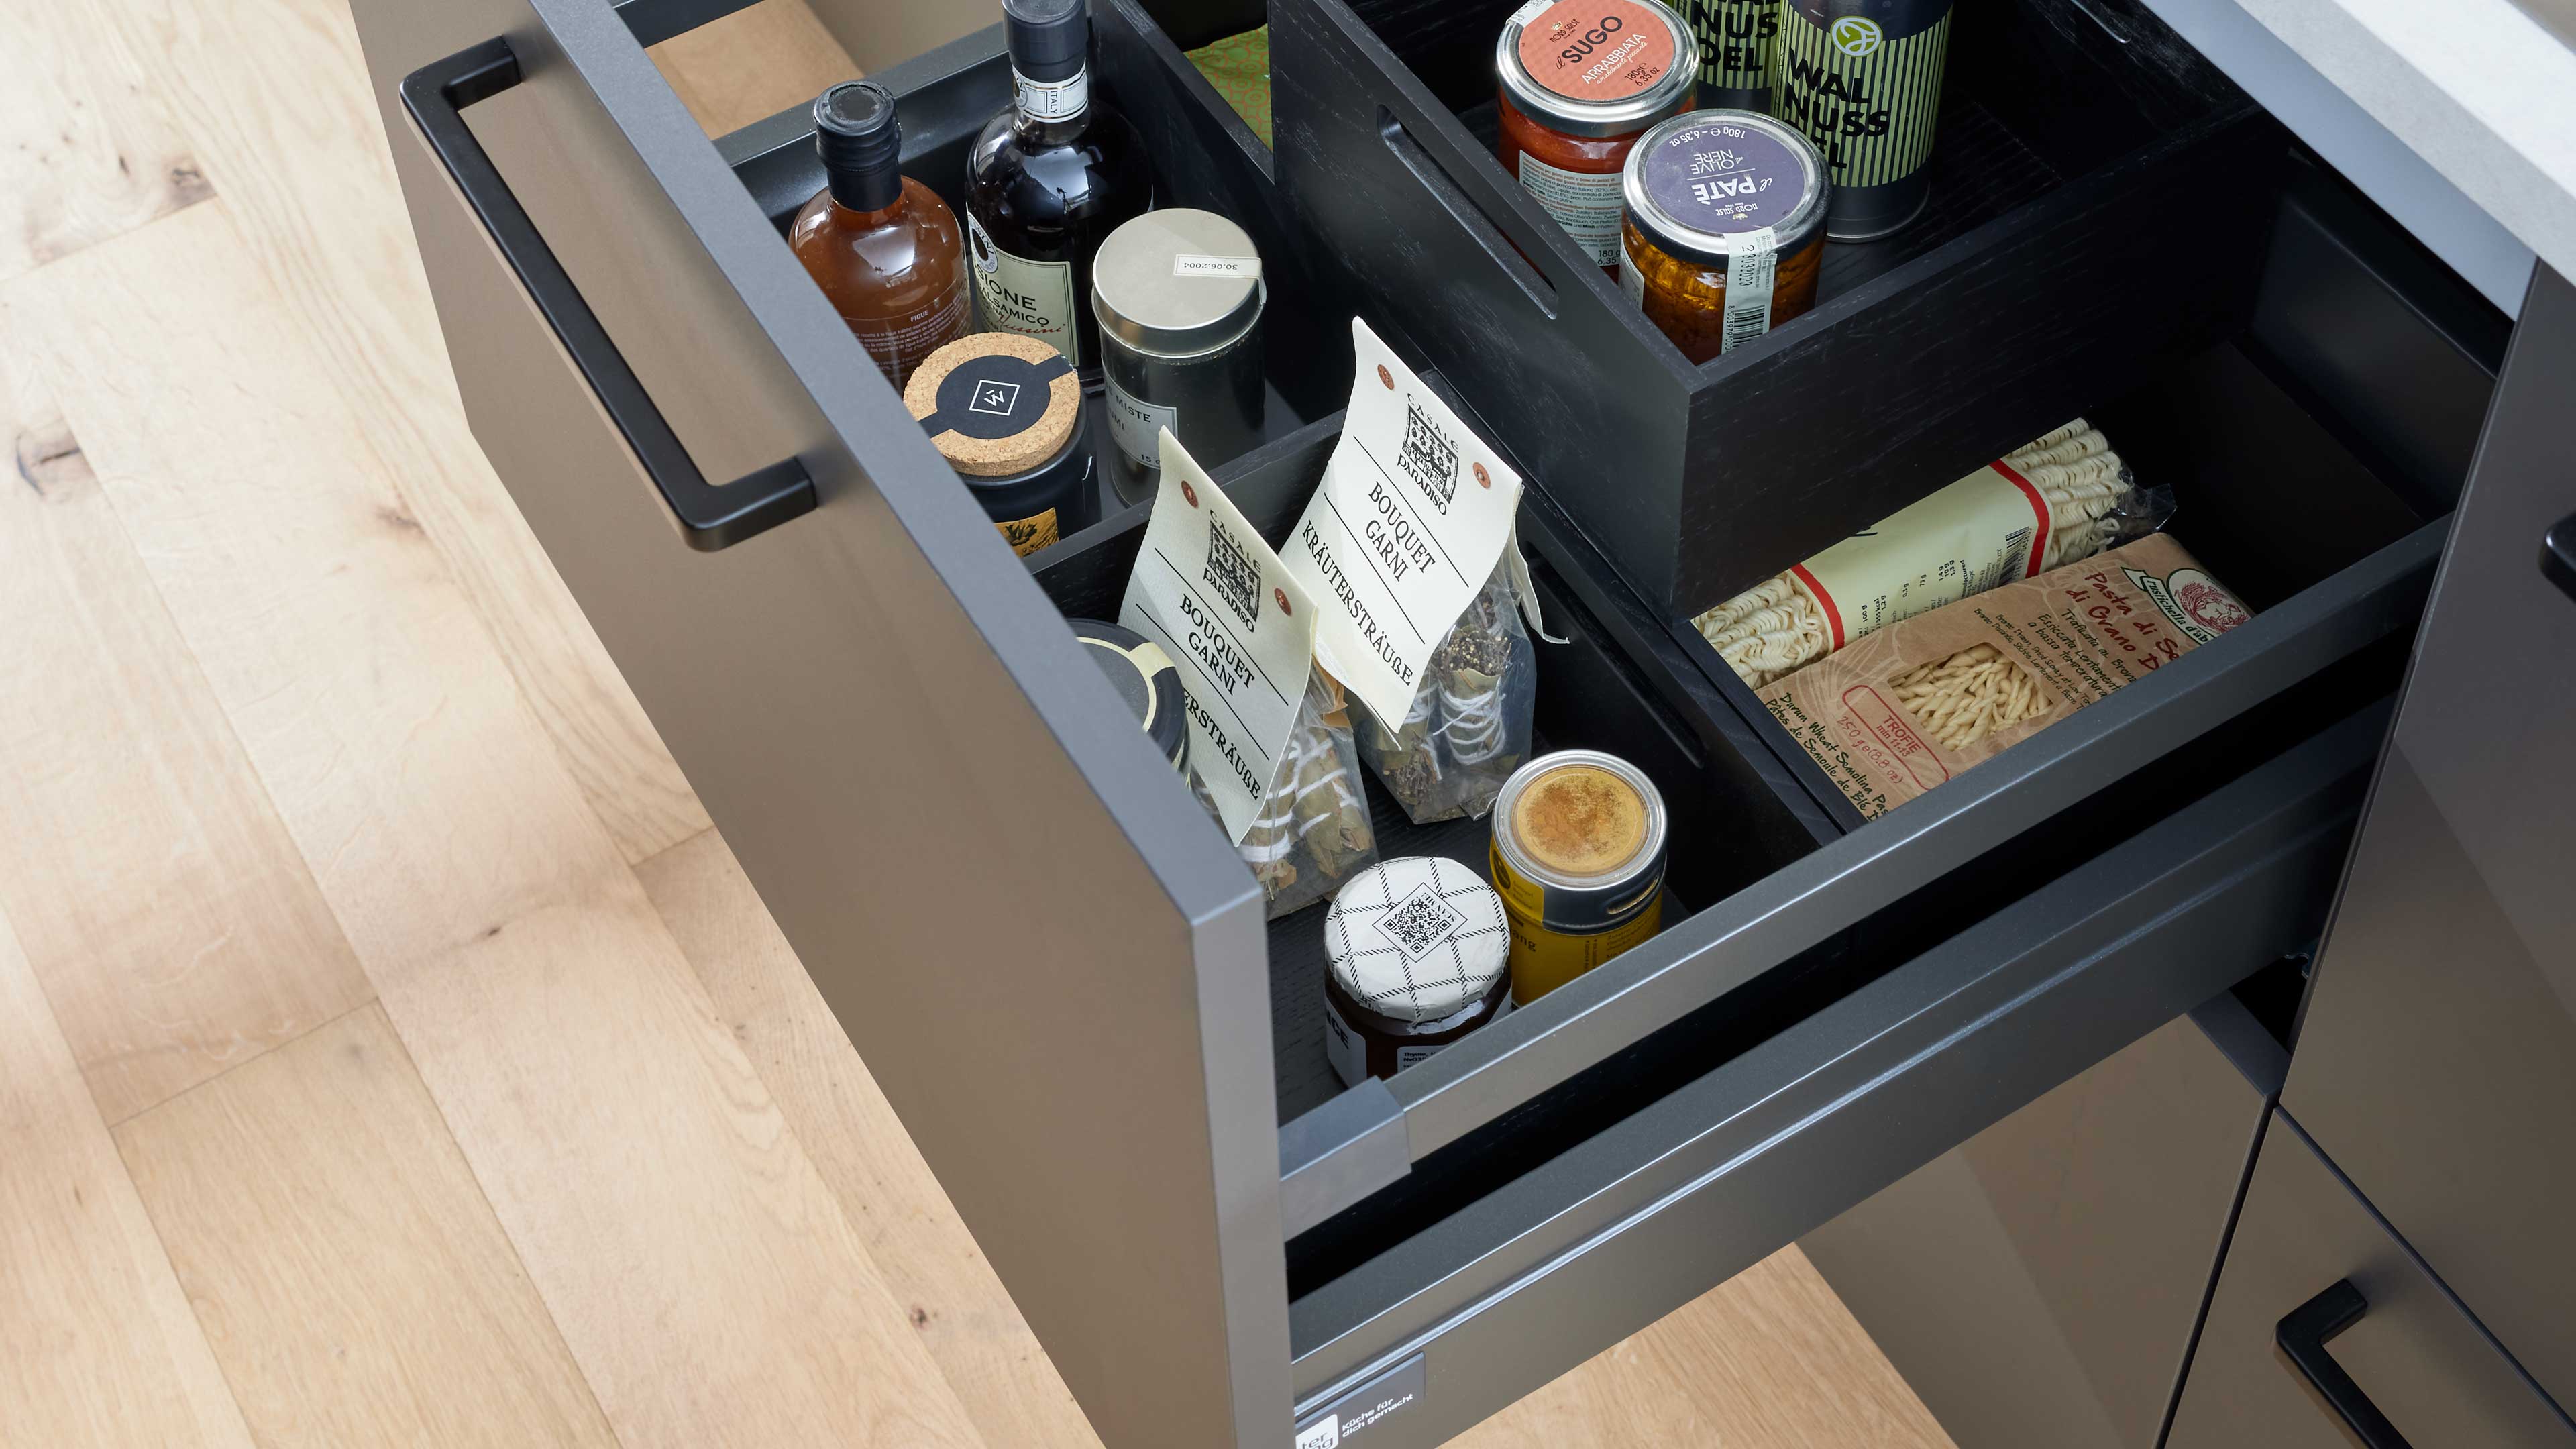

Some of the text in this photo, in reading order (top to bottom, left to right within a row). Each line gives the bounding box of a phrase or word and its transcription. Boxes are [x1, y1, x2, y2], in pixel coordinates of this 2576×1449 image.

[1562, 16, 1623, 64] SUGO
[1693, 3, 1778, 39] NUS
[1581, 34, 1646, 85] ARRABBIATA
[1597, 41, 1648, 85] amabilmente piccante
[1651, 67, 1660, 76] oz
[1789, 46, 1872, 104] WAL
[1050, 90, 1058, 114] ITALY
[1785, 82, 1890, 136] NUSS
[1723, 126, 1746, 139] 180g
[1690, 158, 1735, 175] OLIVE
[1694, 148, 1734, 165] NERE
[1691, 173, 1758, 205] PATÈ
[1183, 262, 1238, 270] 30.06.2004
[1599, 250, 1613, 258] 180
[975, 263, 1036, 311] SIONE
[979, 283, 1049, 326] ALSAMICO
[910, 309, 929, 323] FIGUE
[1116, 395, 1151, 423] MISTE
[1407, 393, 1458, 453] CASALE
[1141, 454, 1151, 462] 15
[1397, 453, 1447, 515] PARADISO
[1210, 509, 1262, 574] CASALE
[1369, 481, 1436, 574] BOUQUET
[1366, 520, 1409, 582] GARNI
[1203, 568, 1254, 633] PARADISO
[2065, 590, 2090, 602] di
[2088, 606, 2137, 652] Grano
[2085, 572, 2132, 615] Pasta
[2133, 621, 2155, 635] di
[2146, 579, 2186, 627] rustichella
[1179, 594, 1255, 689] BOUQUET
[2035, 629, 2060, 651] bassa
[2037, 614, 2076, 649] Essiccata
[1188, 631, 1236, 696] GARNI
[1183, 687, 1261, 800] ERSTRÄUßE
[1780, 692, 1808, 723] Durum
[1808, 722, 1837, 753] Wheat
[1835, 751, 1873, 795] Semolina
[1836, 716, 1860, 737] 250
[1876, 725, 1912, 757] min 11-13
[1883, 714, 1921, 753] TROFIE
[1765, 698, 1870, 812] Pâtes de Semoule de Blé
[1511, 928, 1537, 953] ang
[1342, 1398, 1393, 1432] Küche für
[1342, 1393, 1413, 1438] dich gemacht
